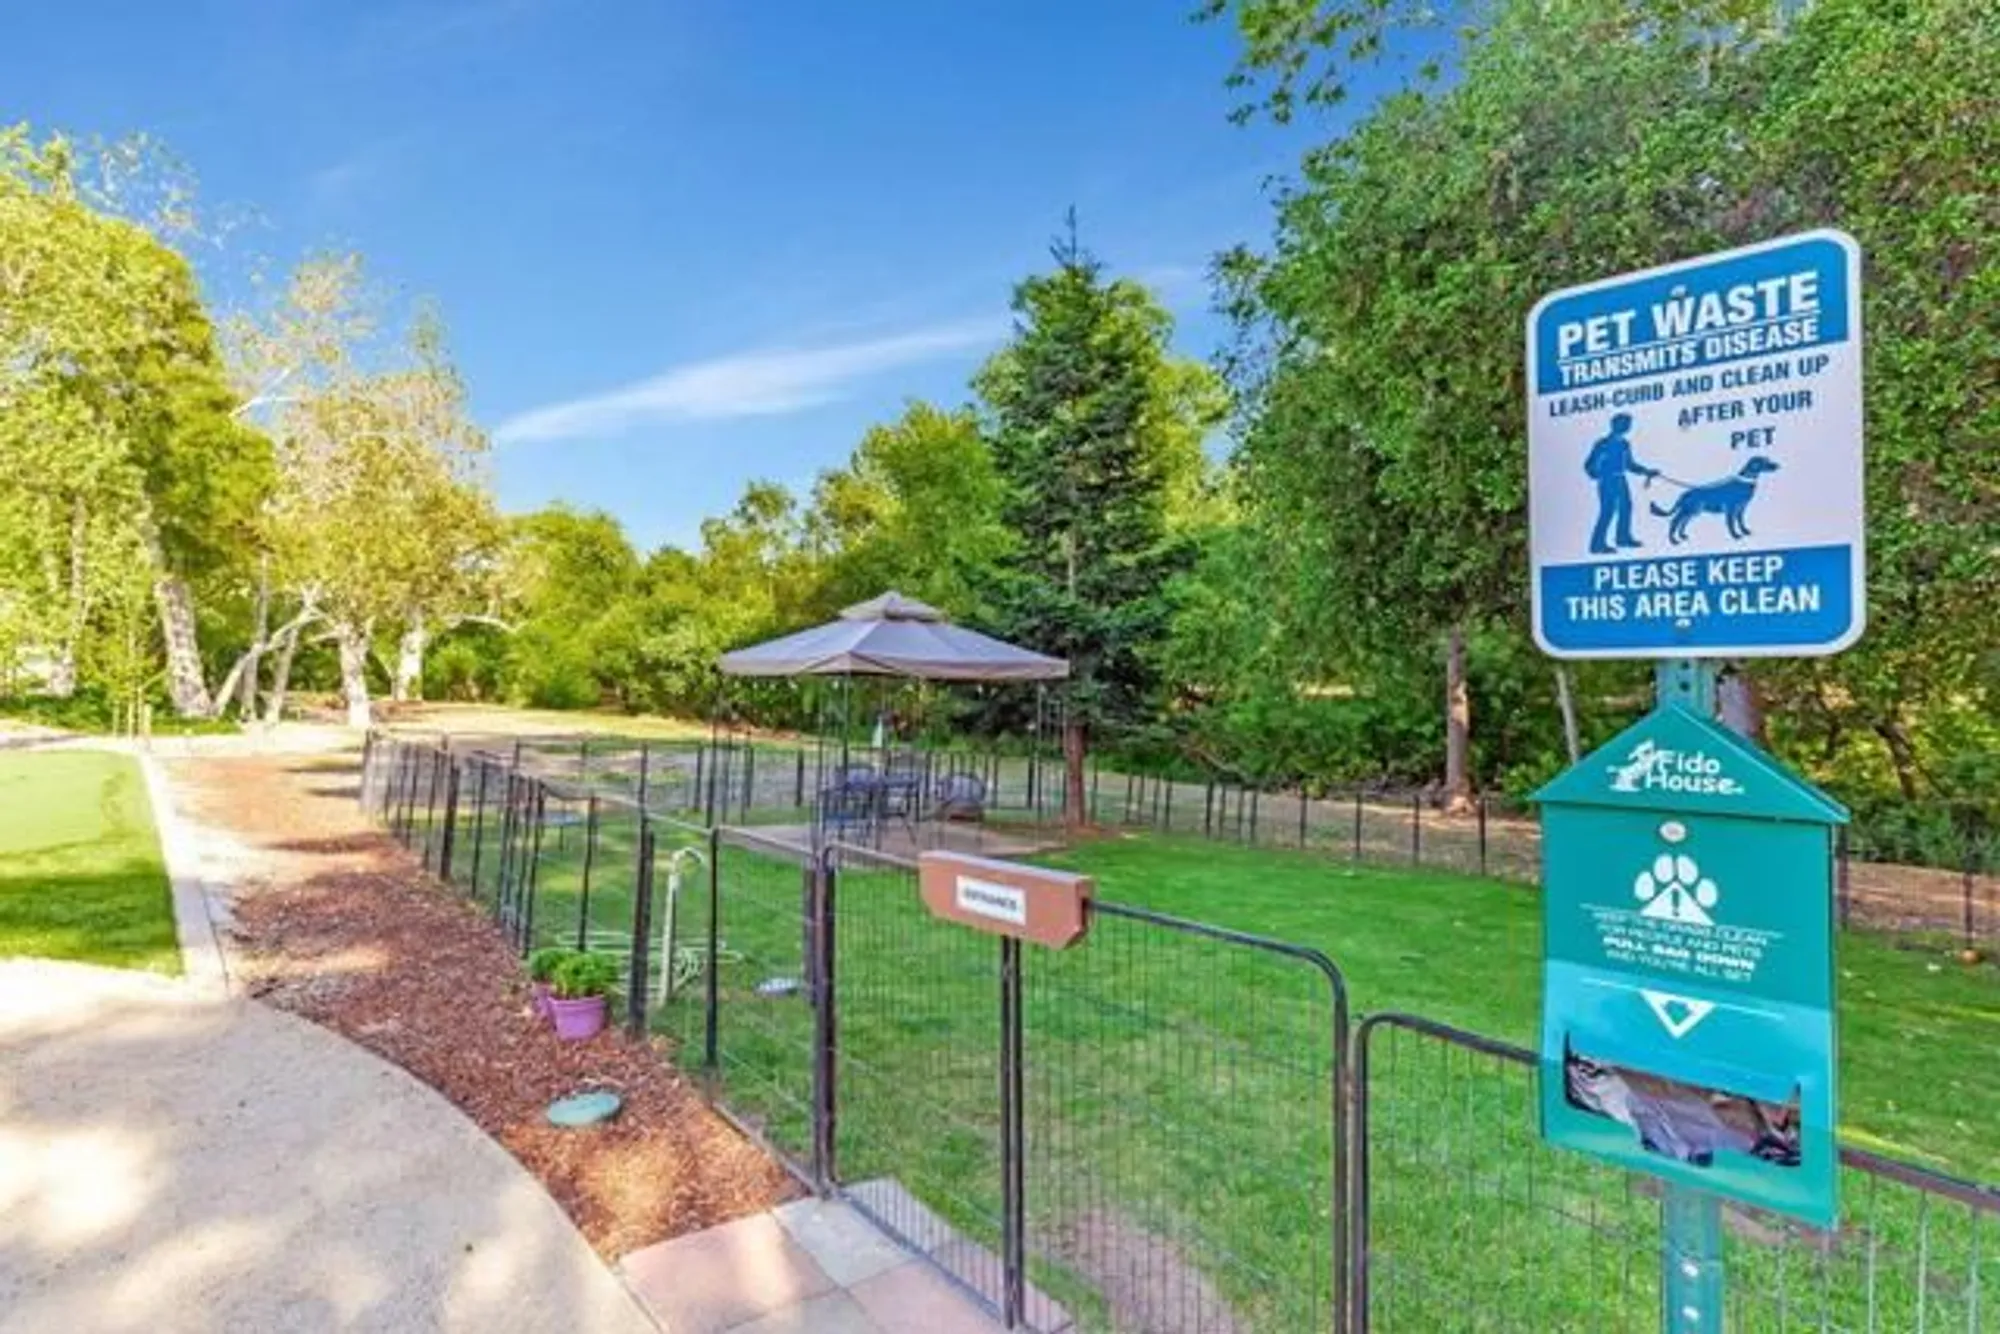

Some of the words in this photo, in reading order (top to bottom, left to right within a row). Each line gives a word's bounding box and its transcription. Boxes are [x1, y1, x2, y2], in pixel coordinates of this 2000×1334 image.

[1558, 311, 1637, 358] PET
[1653, 272, 1819, 339] WASTE
[1558, 341, 1696, 386] TRANSMITS
[1705, 317, 1819, 359] DISEASE
[1672, 374, 1714, 399] AND
[1721, 361, 1790, 391] CLEAN
[1797, 353, 1830, 377] UP
[1678, 397, 1744, 426] AFTER
[1752, 390, 1813, 415] YOUR
[1730, 426, 1776, 449] PET
[1594, 560, 1697, 590] PLEASE
[1708, 555, 1784, 585] KEEP
[1566, 597, 1627, 621] THIS
[1635, 590, 1711, 618] AREA
[1720, 585, 1821, 615] CLEAN
[1656, 749, 1721, 774] Fido
